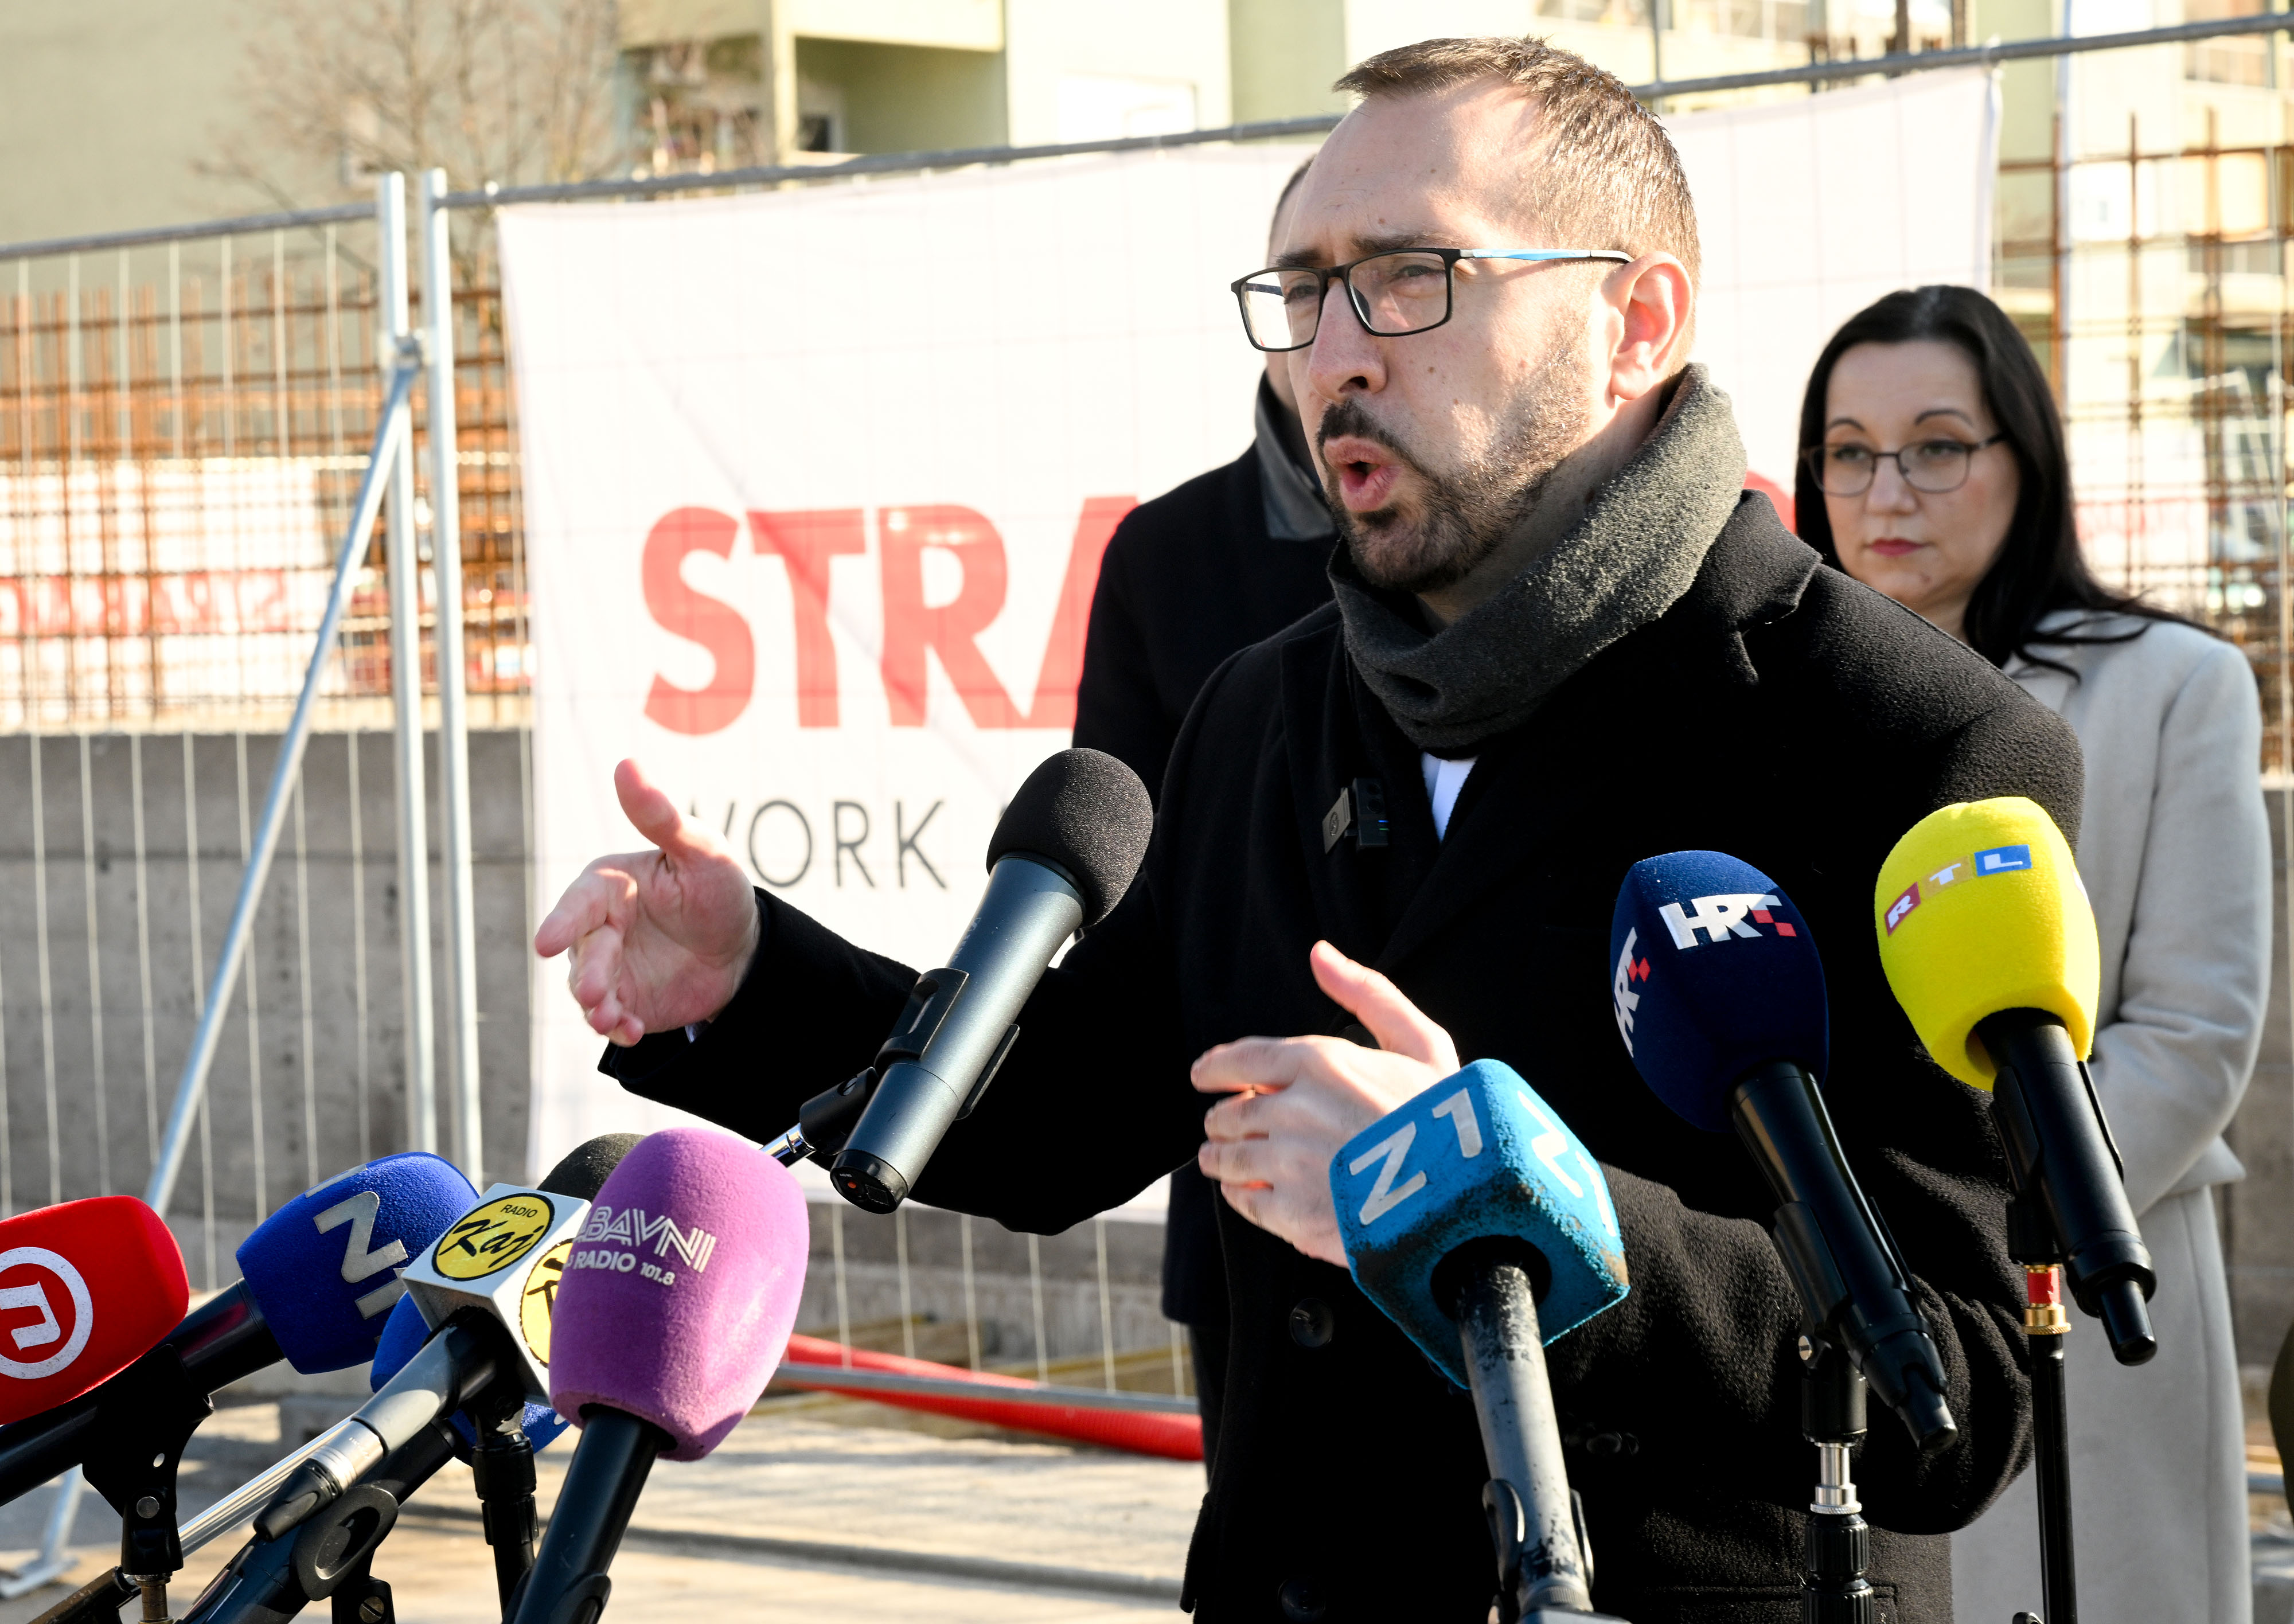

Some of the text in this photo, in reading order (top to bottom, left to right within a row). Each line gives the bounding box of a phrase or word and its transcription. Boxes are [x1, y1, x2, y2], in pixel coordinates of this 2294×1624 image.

[1887, 853, 2023, 928] RTL
[1658, 893, 1797, 950] HRT
[1348, 1087, 1483, 1226] Z1
[500, 1204, 538, 1218] RADIO
[438, 1219, 545, 1268] Kaj
[574, 1250, 637, 1273] RADIO
[640, 1262, 676, 1286] 101.8
